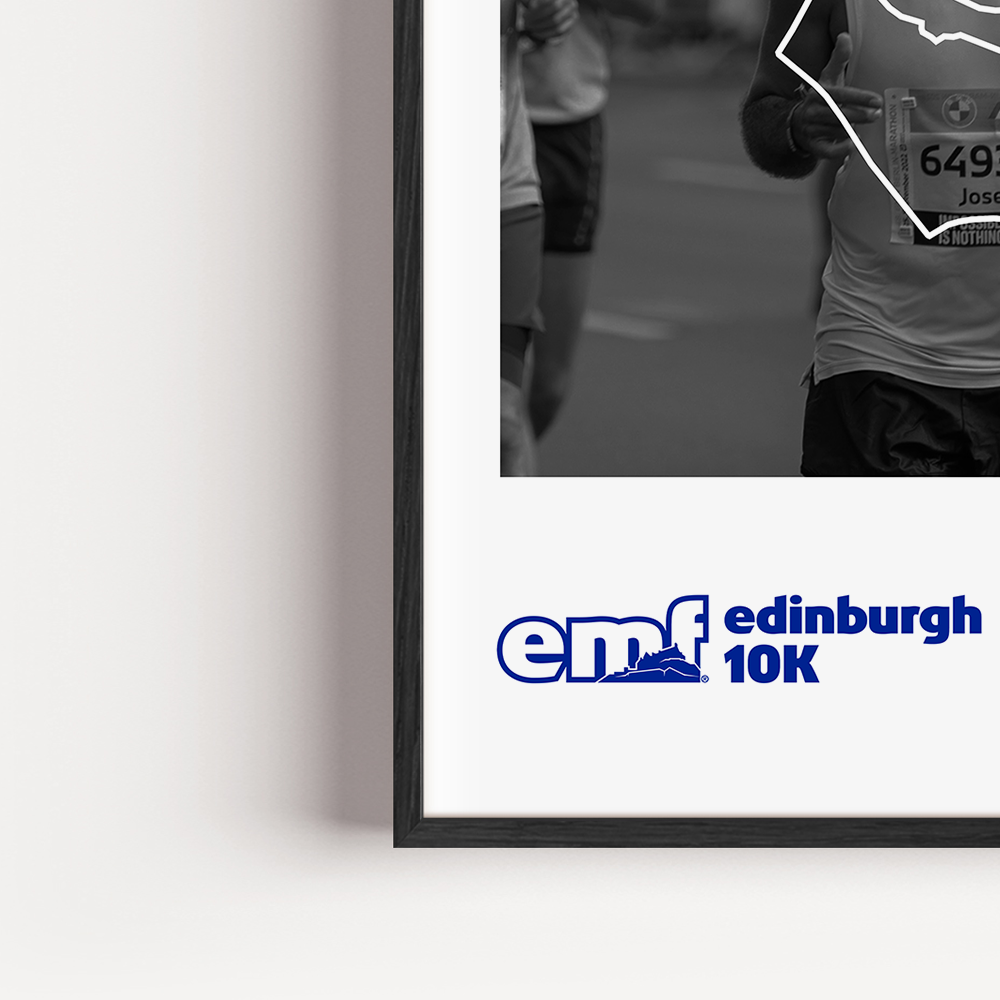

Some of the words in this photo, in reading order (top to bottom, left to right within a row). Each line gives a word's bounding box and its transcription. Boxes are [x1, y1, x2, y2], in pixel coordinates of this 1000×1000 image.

[938, 231, 951, 245] IS
[497, 595, 709, 683] emf
[724, 595, 982, 645] edinburgh
[724, 644, 820, 683] 10K
